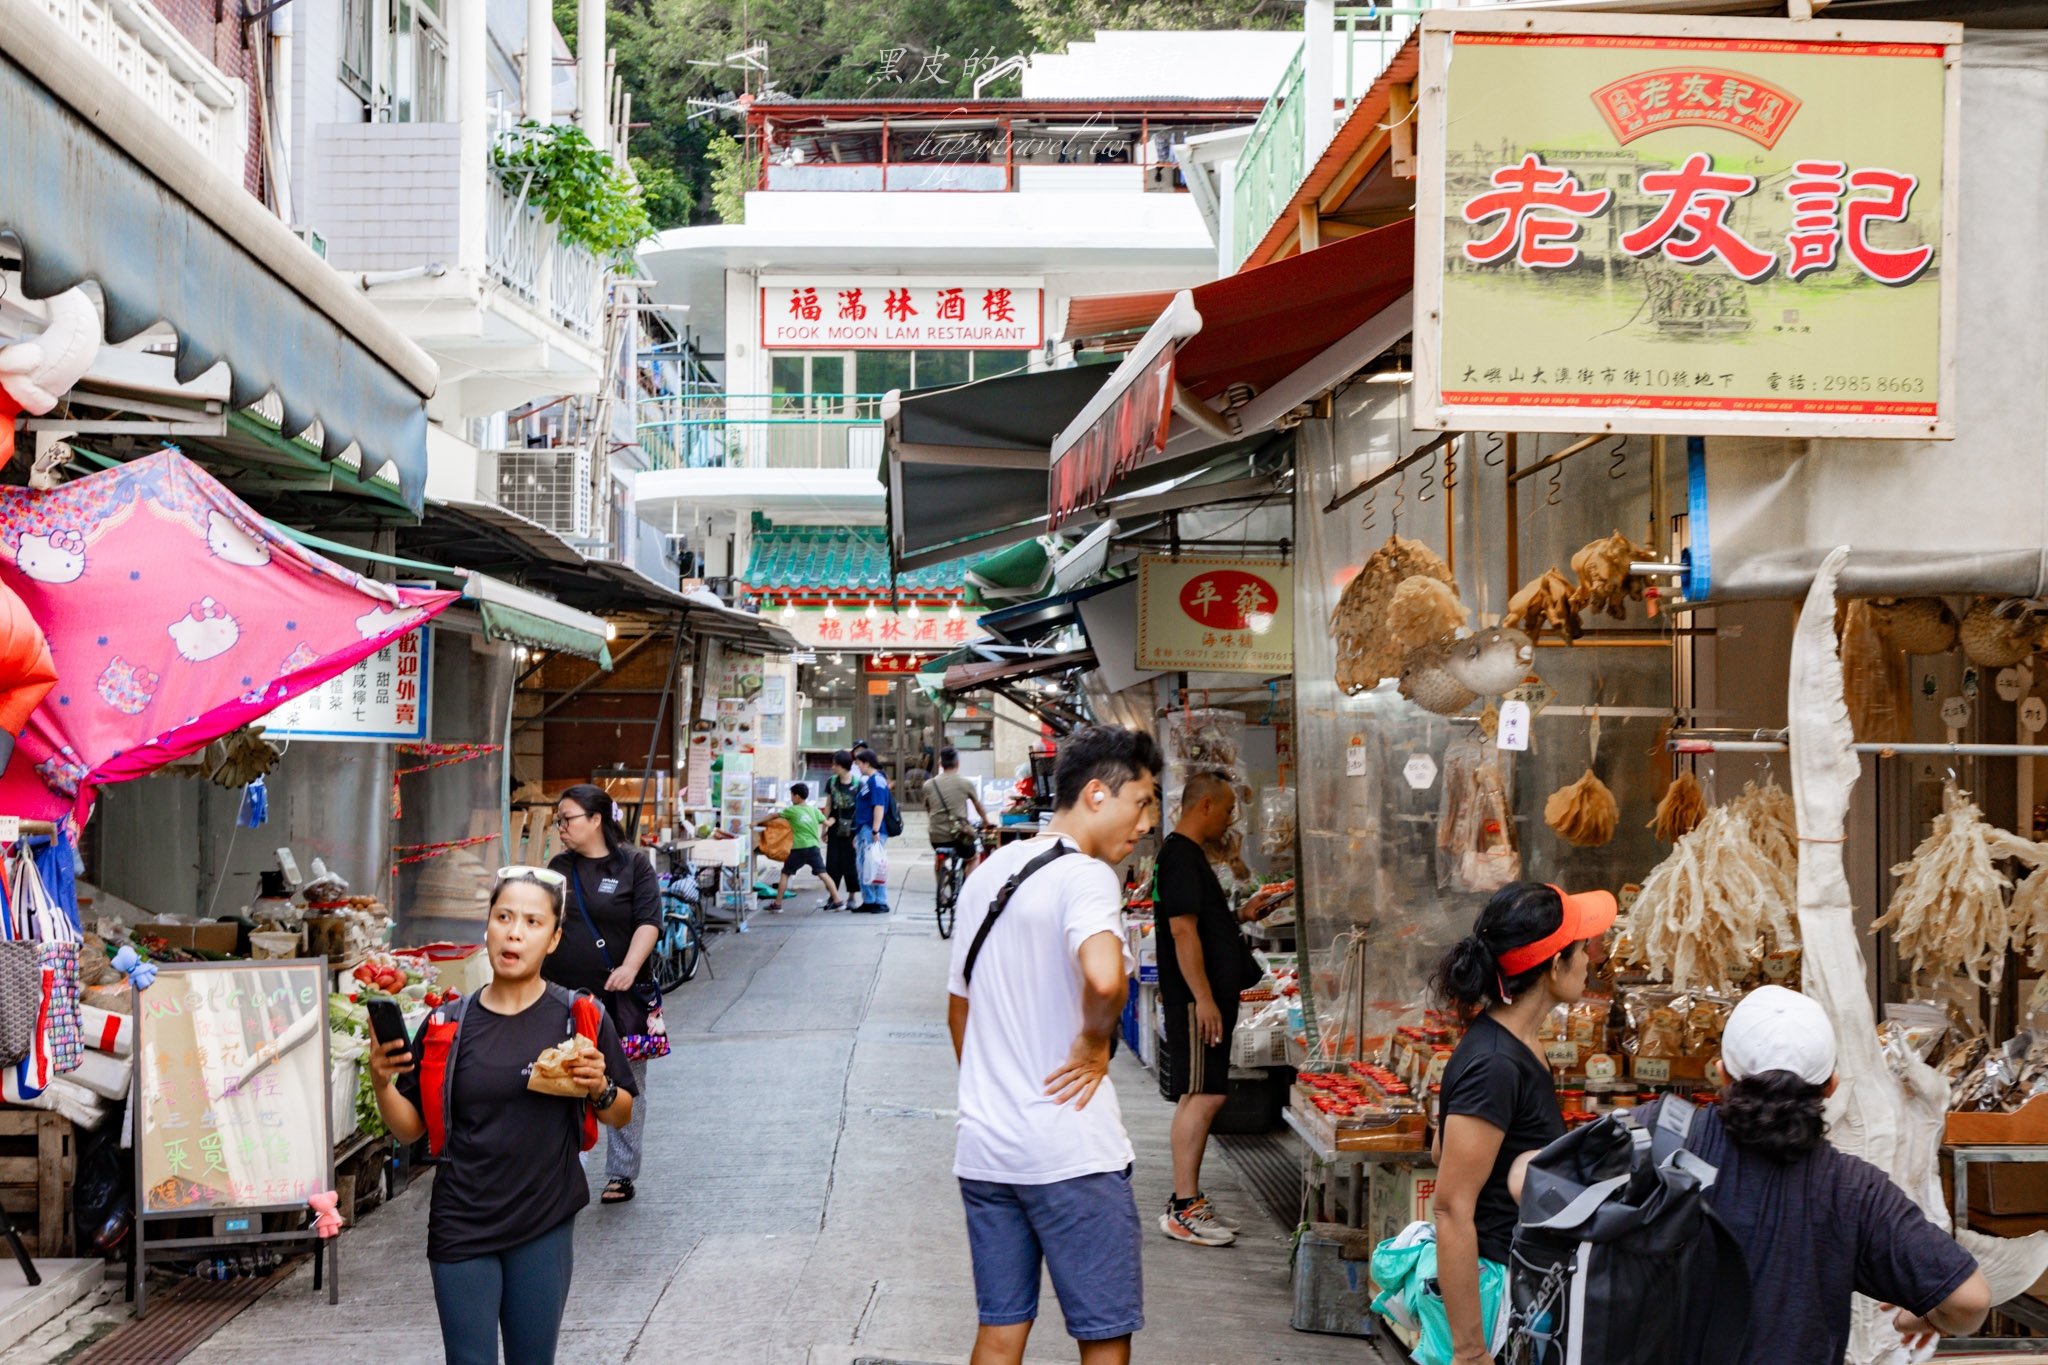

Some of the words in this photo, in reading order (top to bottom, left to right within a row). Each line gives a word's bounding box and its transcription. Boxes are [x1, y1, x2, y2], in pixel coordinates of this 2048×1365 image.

[1638, 75, 1756, 115] 老友記
[1462, 152, 1933, 284] 老友記
[789, 287, 1016, 323] 福滿林酒樓
[777, 326, 819, 340] FOOK
[828, 326, 878, 340] MOON
[885, 326, 920, 340] LAM
[927, 326, 1026, 340] RESTAURANT
[1823, 374, 1872, 392] 2985
[1876, 375, 1925, 393] 8663
[394, 632, 419, 725] 歡迎外賣
